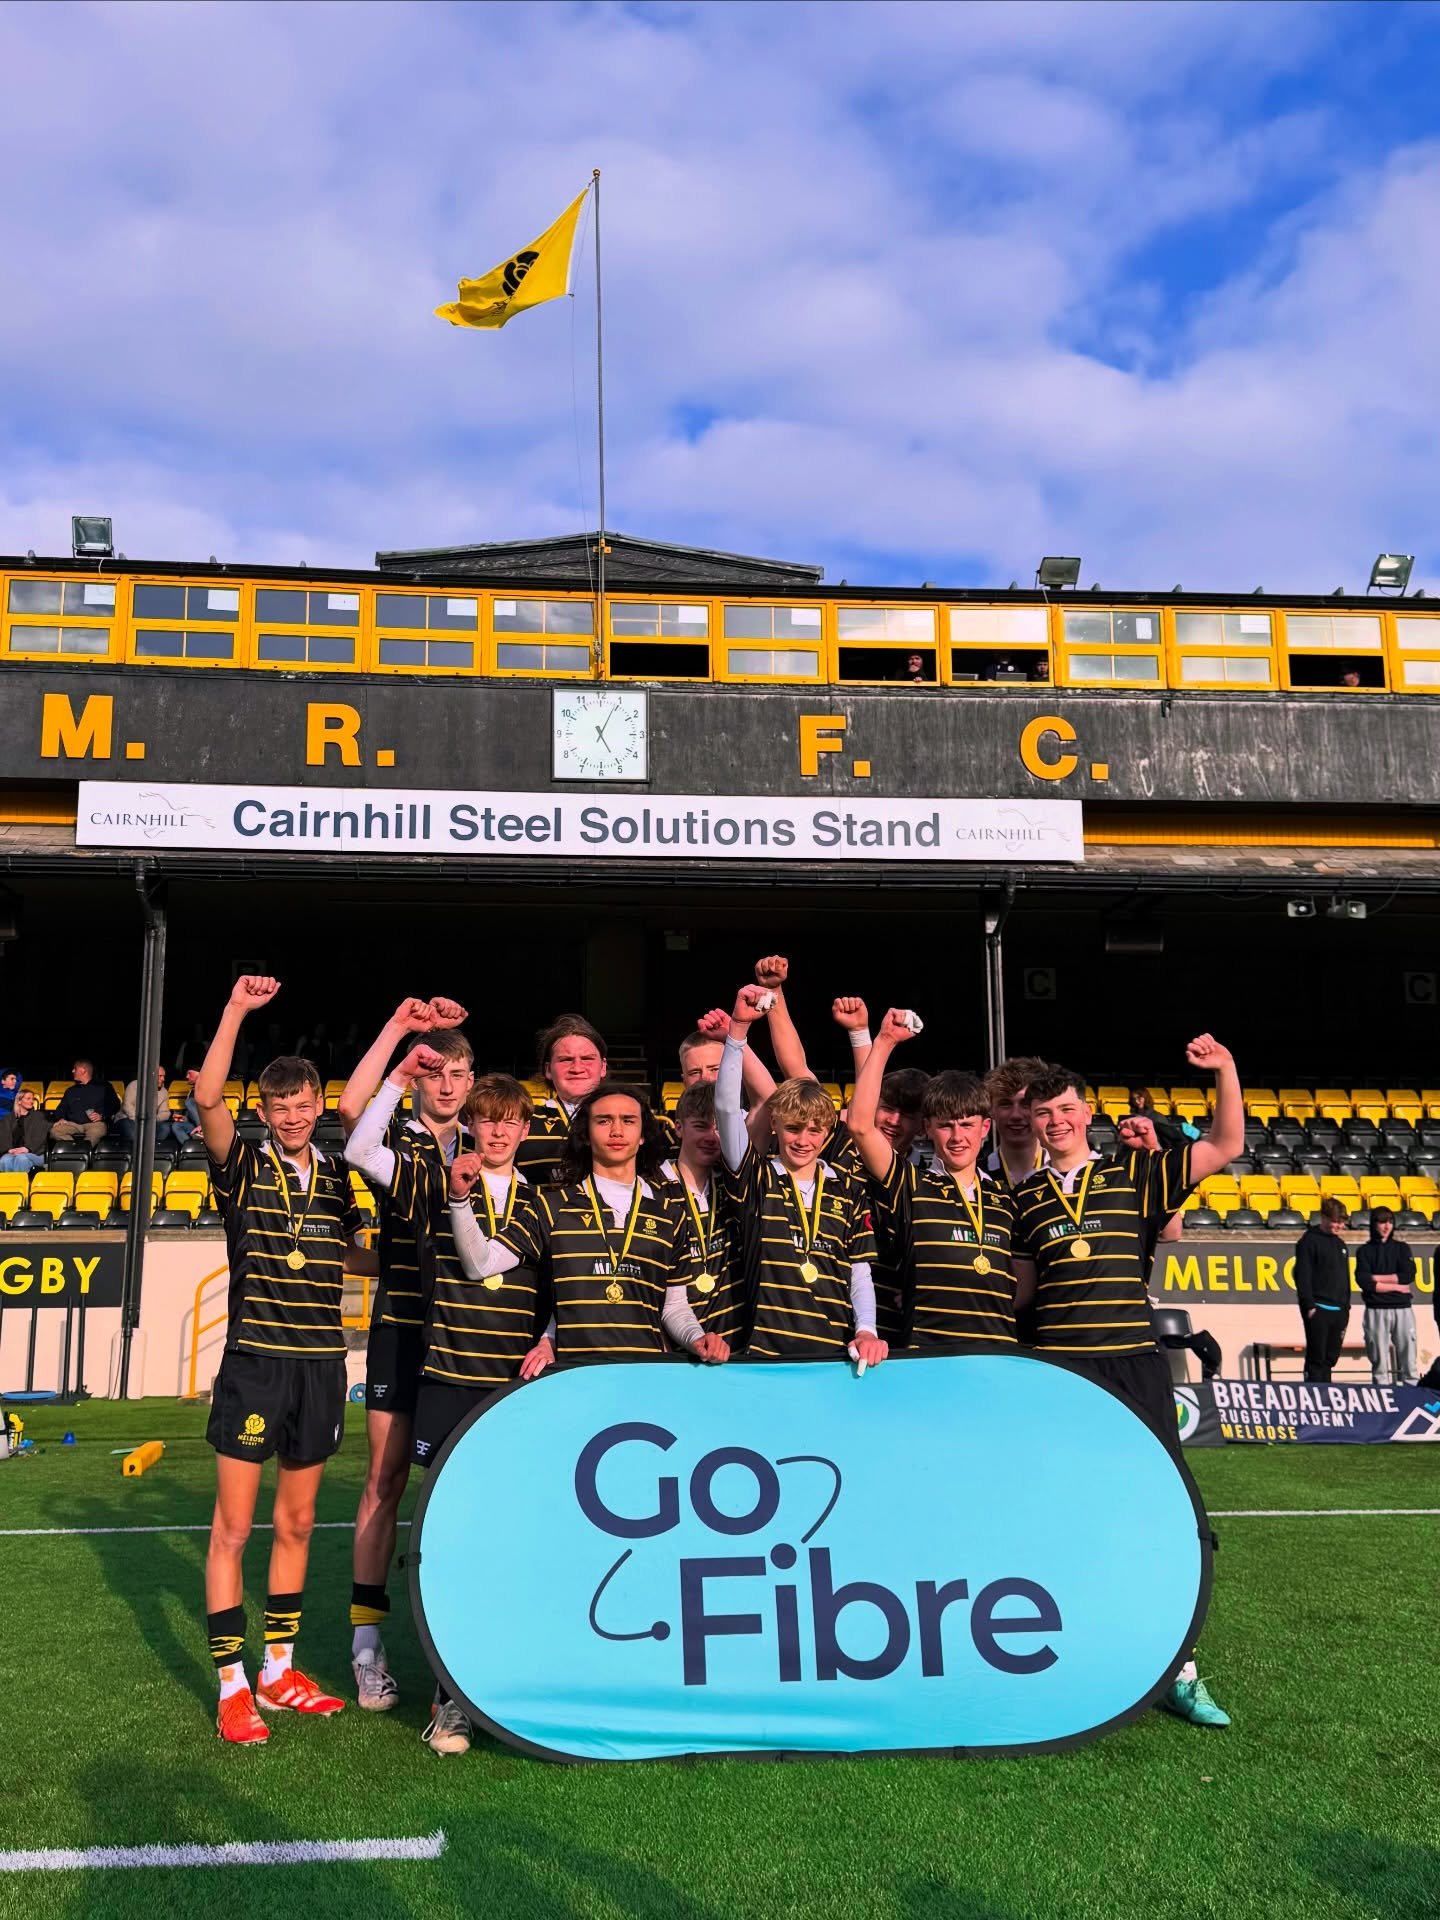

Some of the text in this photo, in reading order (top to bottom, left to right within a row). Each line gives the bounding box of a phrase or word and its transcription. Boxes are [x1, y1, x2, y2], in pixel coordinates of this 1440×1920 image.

[576, 695, 586, 704] 11
[596, 691, 607, 700] 12
[618, 696, 622, 705] 1
[561, 709, 571, 717] 10
[633, 710, 639, 718] 2
[40, 693, 1109, 780] M. R. F. C.
[556, 729, 562, 738] 9
[639, 730, 645, 739] 3
[563, 750, 569, 759] 8
[632, 751, 638, 759] 4
[579, 765, 585, 773] 7
[598, 769, 604, 777] 6
[618, 765, 623, 774] 5
[90, 812, 188, 828] CAIRNHILL
[233, 799, 941, 848] Cairnhill Steel Solutions Stand
[956, 828, 1045, 841] CAIRNHILL
[1026, 968, 1051, 998] C
[1407, 973, 1433, 1002] C
[1164, 1255, 1362, 1292] MELR
[1211, 1381, 1400, 1413] BREADALBANE
[1219, 1408, 1354, 1428] RUGBY ACADEMY
[1220, 1423, 1298, 1441] MELROSE
[574, 1421, 781, 1539] Go
[679, 1542, 1063, 1686] Fibre
